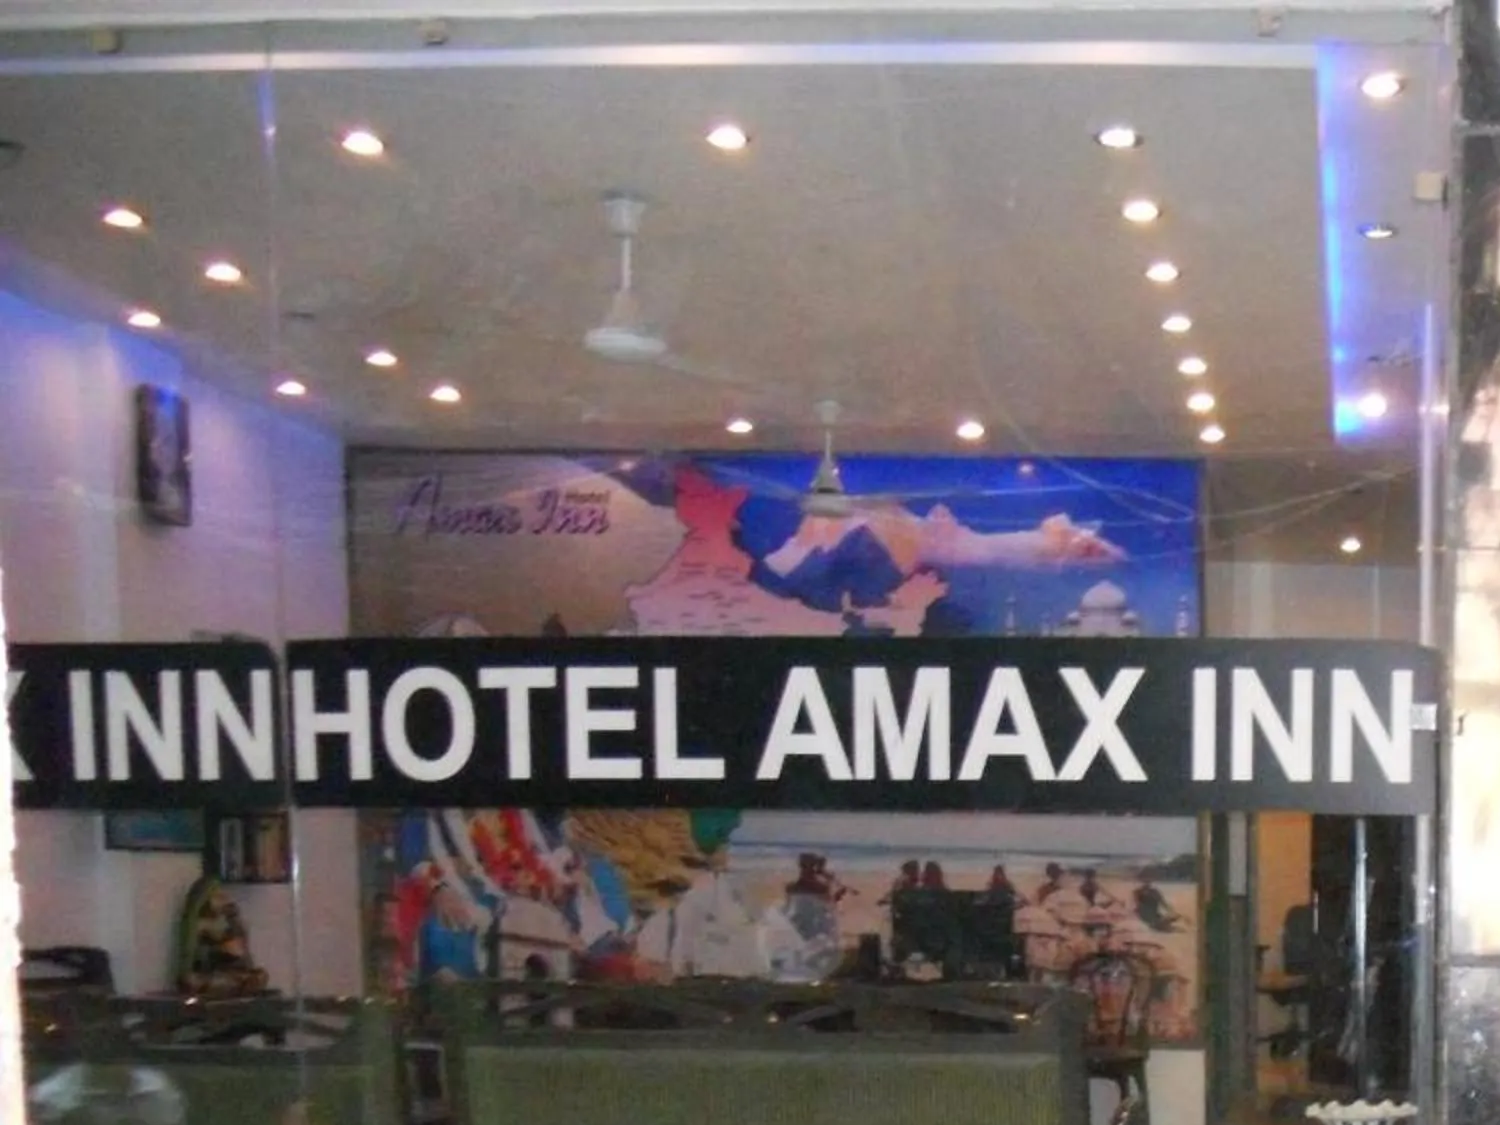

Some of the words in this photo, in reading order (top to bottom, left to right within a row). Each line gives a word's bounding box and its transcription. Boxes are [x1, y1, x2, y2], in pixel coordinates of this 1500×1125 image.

[532, 487, 610, 534] Inn
[68, 668, 275, 781] INN
[292, 666, 725, 782] HOTEL
[755, 666, 1148, 782] AMAX
[1191, 666, 1414, 783] INN
